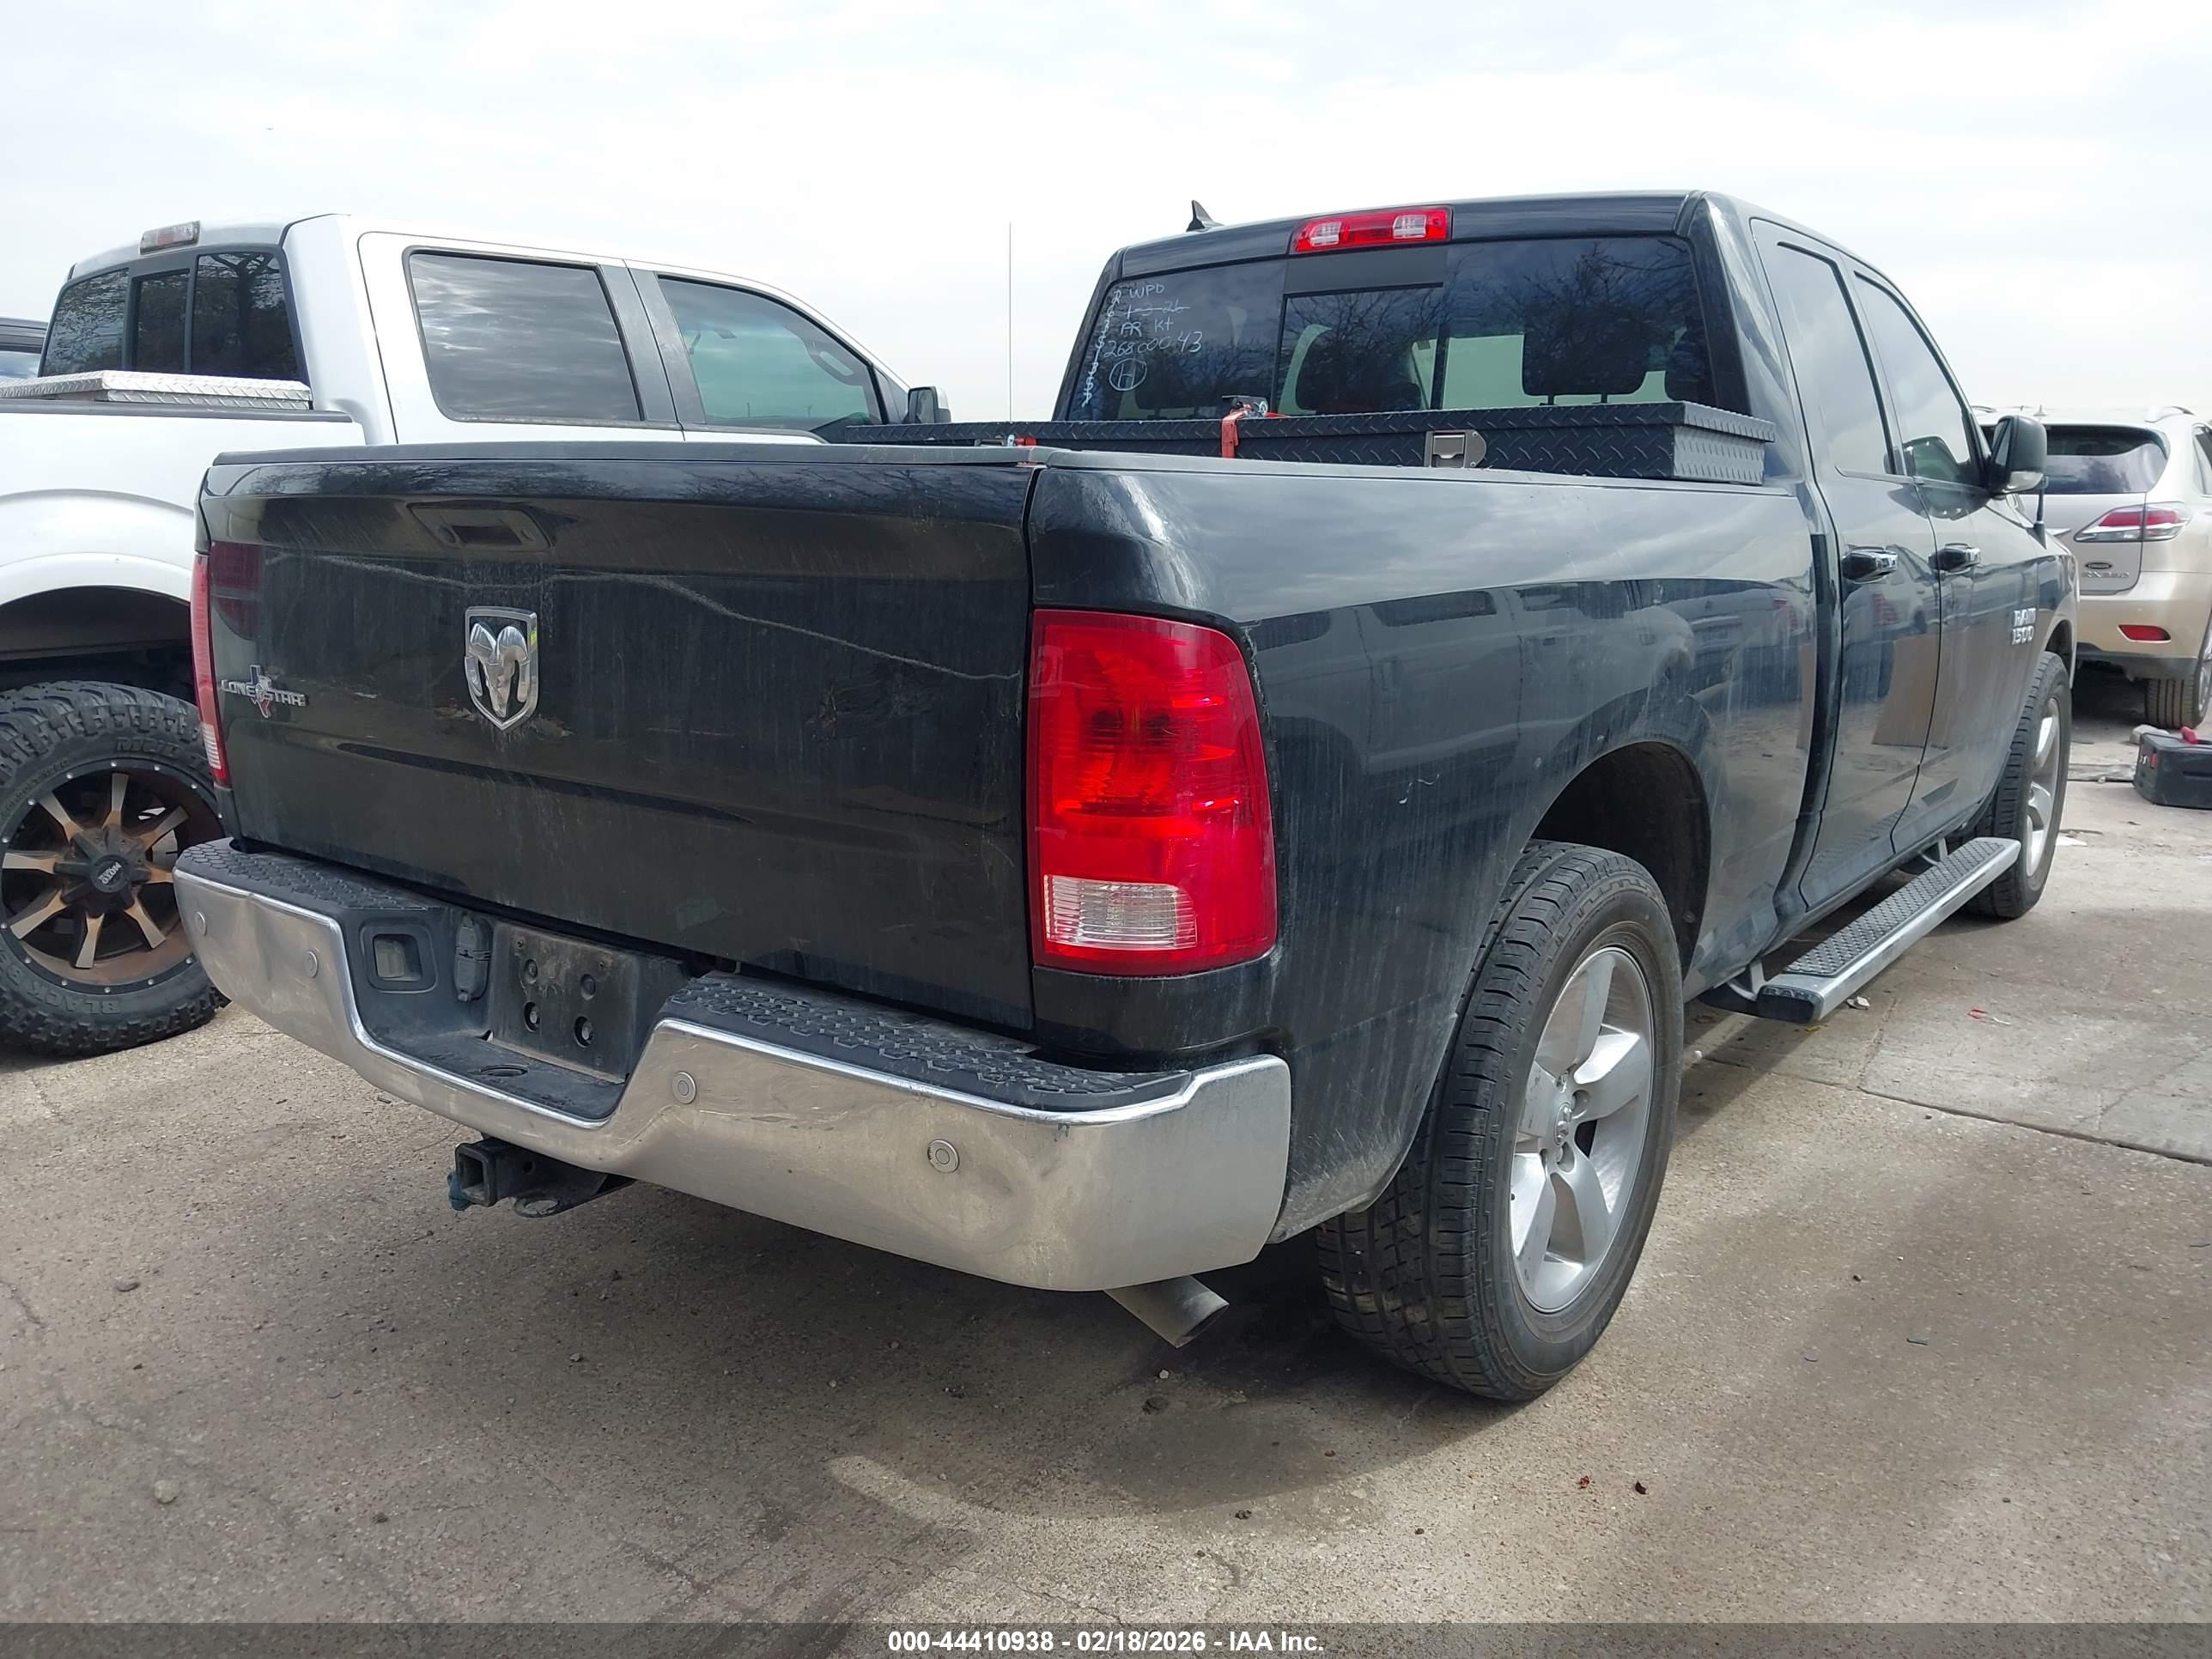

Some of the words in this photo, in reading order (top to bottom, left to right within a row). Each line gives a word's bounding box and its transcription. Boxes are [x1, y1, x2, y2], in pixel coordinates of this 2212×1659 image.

[1129, 283, 1165, 299] WPD
[2013, 607, 2037, 627] RAM
[2011, 625, 2034, 646] 1500
[221, 678, 256, 697] LONE
[261, 690, 307, 708] STAR
